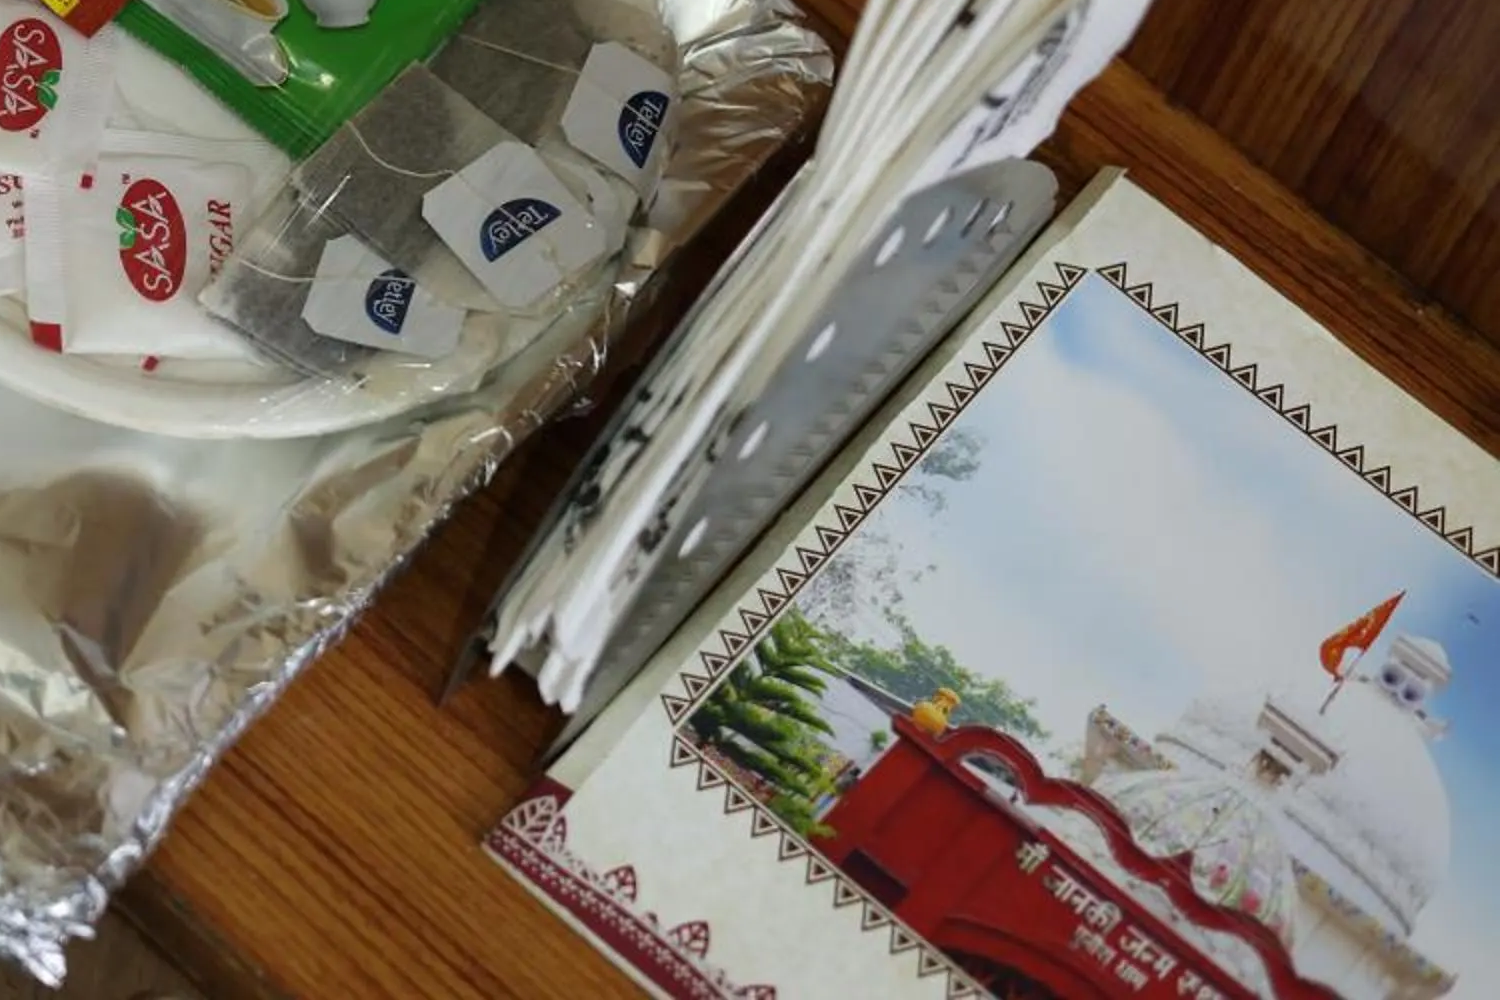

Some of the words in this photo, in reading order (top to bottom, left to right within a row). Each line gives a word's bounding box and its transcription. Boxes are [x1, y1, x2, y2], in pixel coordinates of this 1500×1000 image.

[626, 99, 663, 160] Tetley
[134, 192, 173, 294] SASA
[489, 204, 550, 252] Tetley
